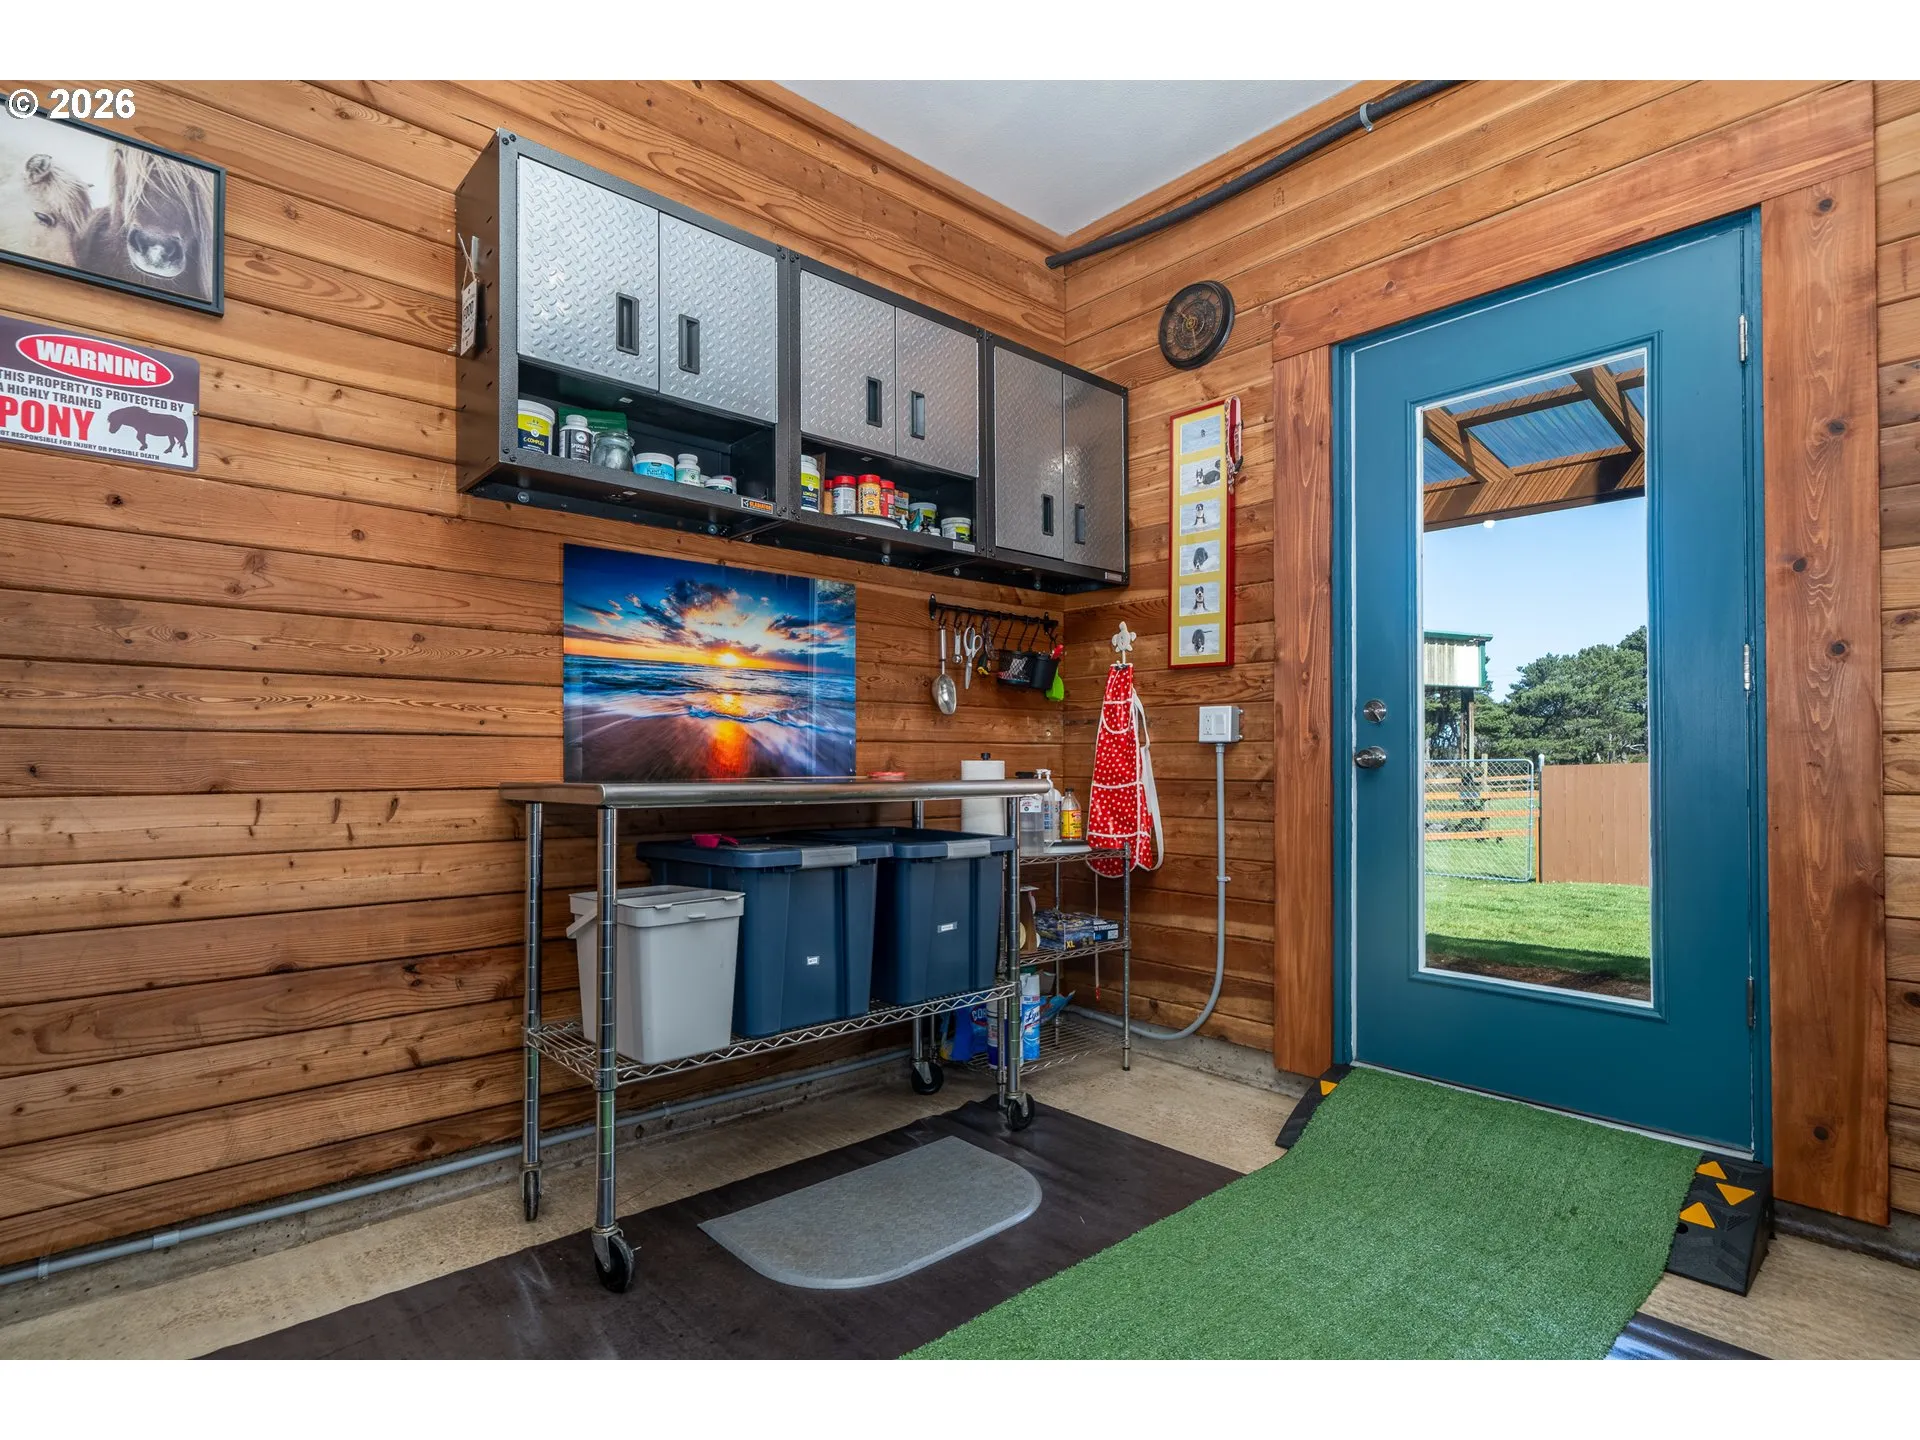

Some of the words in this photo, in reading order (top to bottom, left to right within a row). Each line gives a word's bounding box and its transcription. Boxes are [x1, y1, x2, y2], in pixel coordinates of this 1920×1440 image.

[35, 338, 157, 383] WARNING
[7, 383, 50, 400] HIGHLY
[52, 391, 102, 410] TRAINED
[28, 374, 89, 395] PROPERTY
[91, 386, 103, 398] IS
[105, 389, 168, 410] PROTECTED
[170, 401, 184, 413] BY
[0, 395, 95, 441] PONY
[11, 430, 58, 445] RESPONSIBLE
[59, 439, 73, 447] FOR
[73, 441, 97, 451] INJURY
[98, 445, 108, 453] OR
[108, 447, 139, 458] POSSIBLE
[140, 452, 160, 461] DEATH
[1066, 940, 1076, 949] XL
